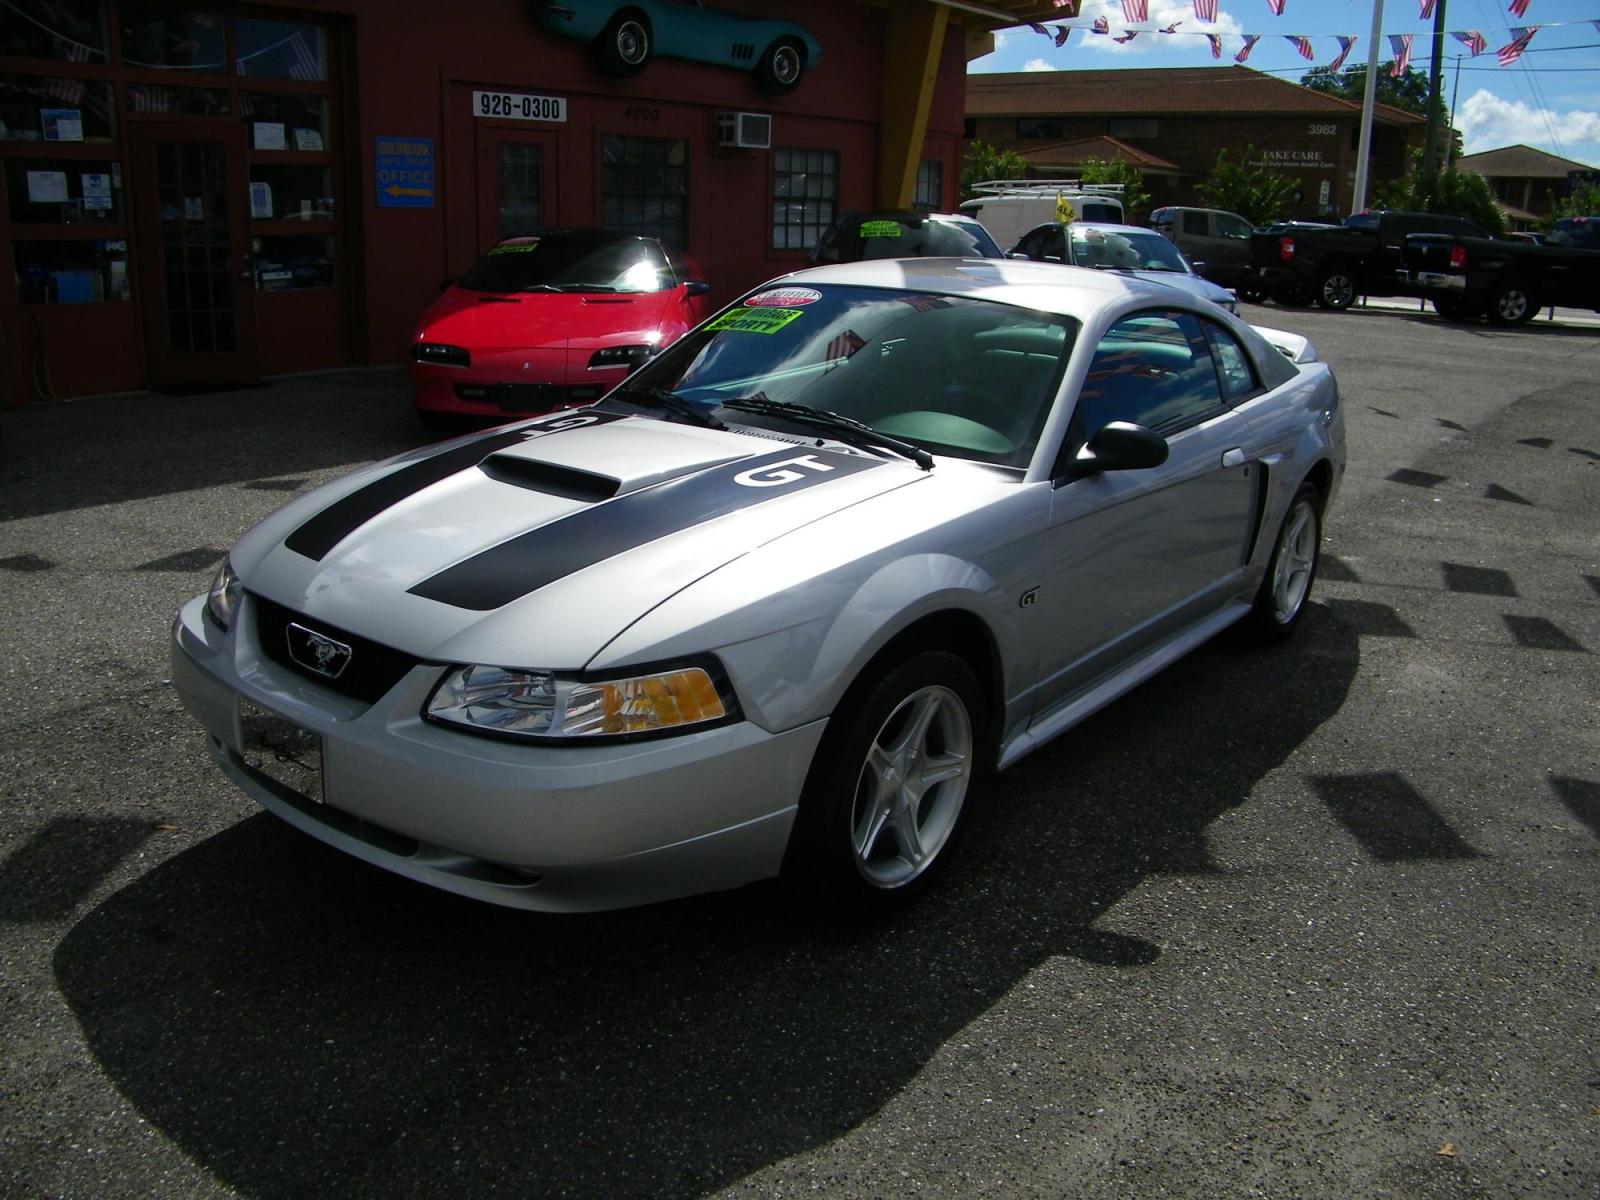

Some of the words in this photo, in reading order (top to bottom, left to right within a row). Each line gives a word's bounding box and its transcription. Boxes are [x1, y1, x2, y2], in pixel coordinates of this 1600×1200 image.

[481, 94, 560, 119] 926-0300
[1308, 124, 1337, 135] 3982
[1263, 151, 1290, 160] TAKE
[1292, 151, 1322, 160] CARE
[380, 169, 432, 184] OFFICE
[1057, 204, 1075, 218] ALE
[709, 319, 782, 331] SPORTY
[733, 454, 835, 487] GT
[1019, 585, 1041, 608] GT
